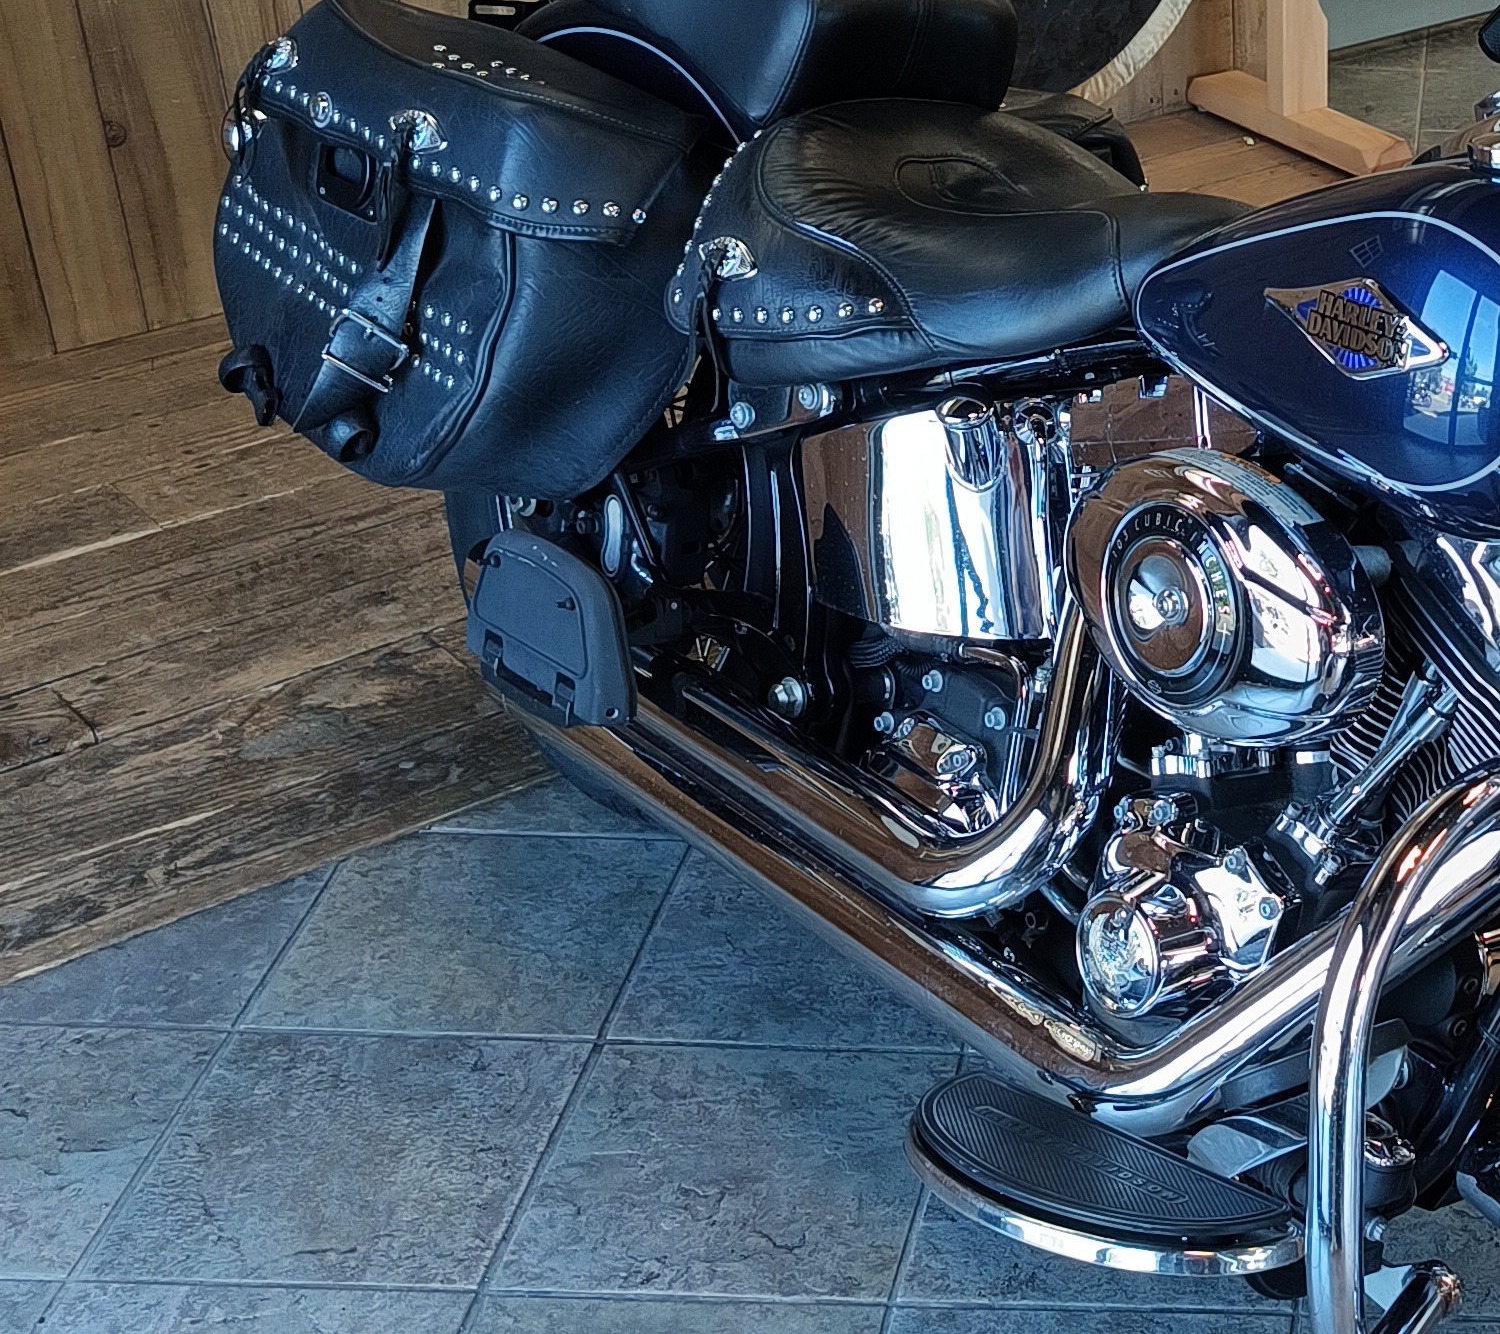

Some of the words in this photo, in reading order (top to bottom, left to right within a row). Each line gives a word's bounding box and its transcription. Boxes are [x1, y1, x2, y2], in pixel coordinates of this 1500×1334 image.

[1112, 528, 1130, 558] 103
[1134, 512, 1183, 533] CUBIC
[1189, 531, 1231, 615] INCHES
